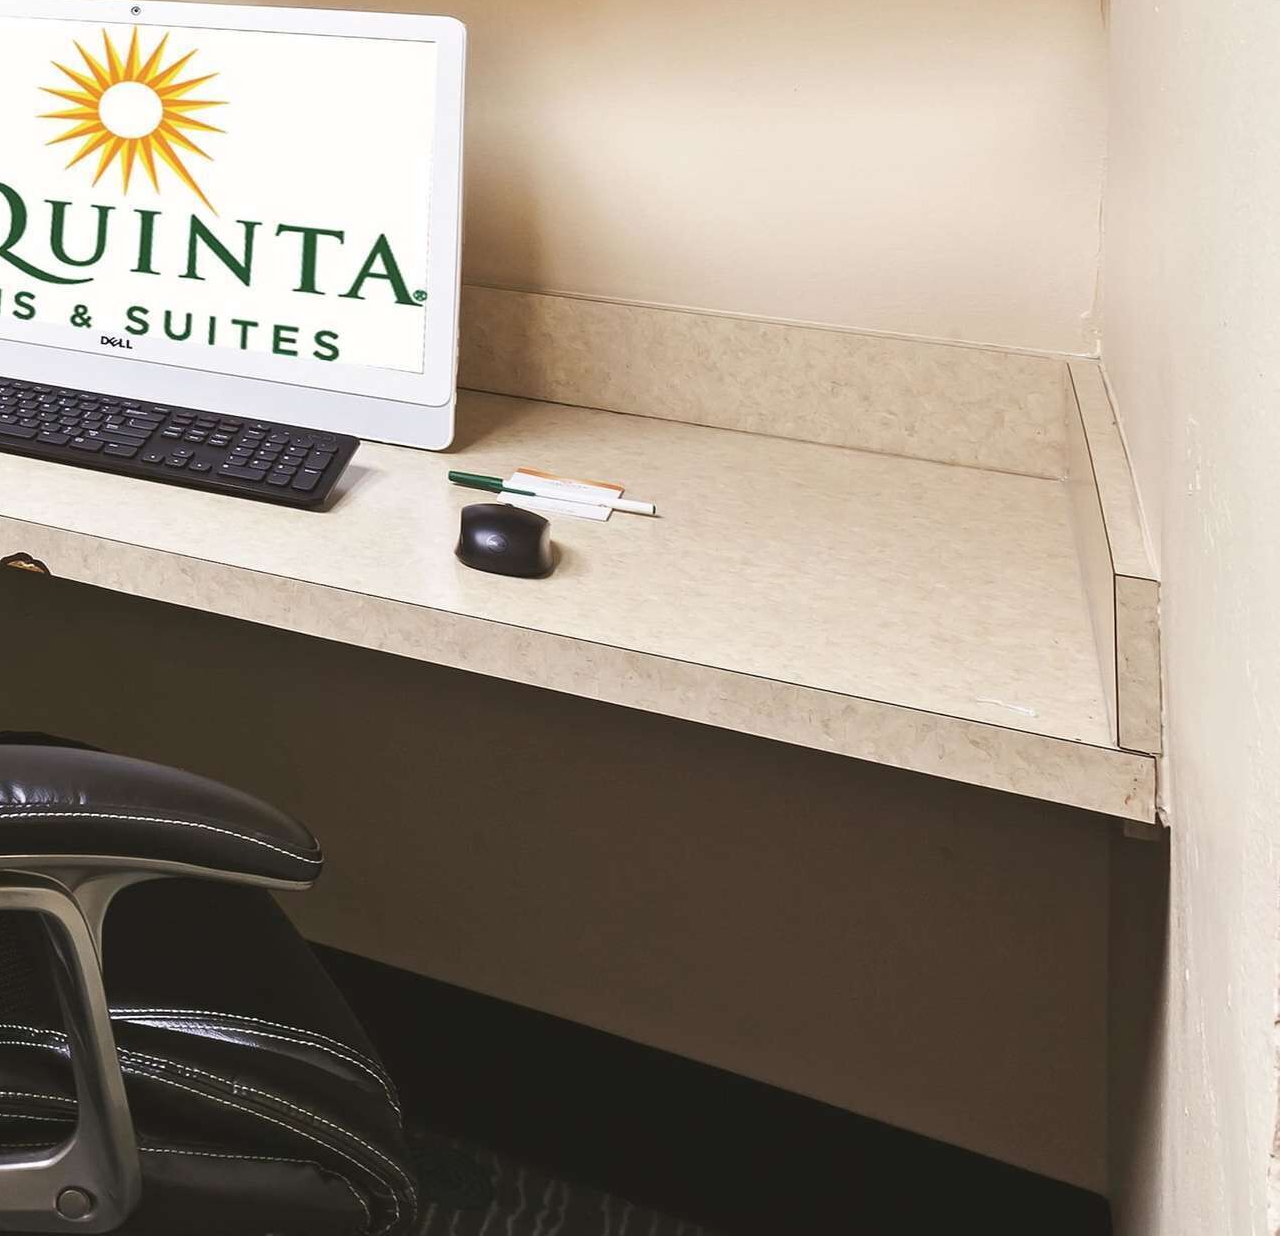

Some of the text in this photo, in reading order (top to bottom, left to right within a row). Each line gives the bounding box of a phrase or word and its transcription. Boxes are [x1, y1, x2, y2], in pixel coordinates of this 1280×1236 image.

[70, 304, 93, 329] &
[124, 305, 341, 362] SUITES
[100, 335, 133, 350] DELL
